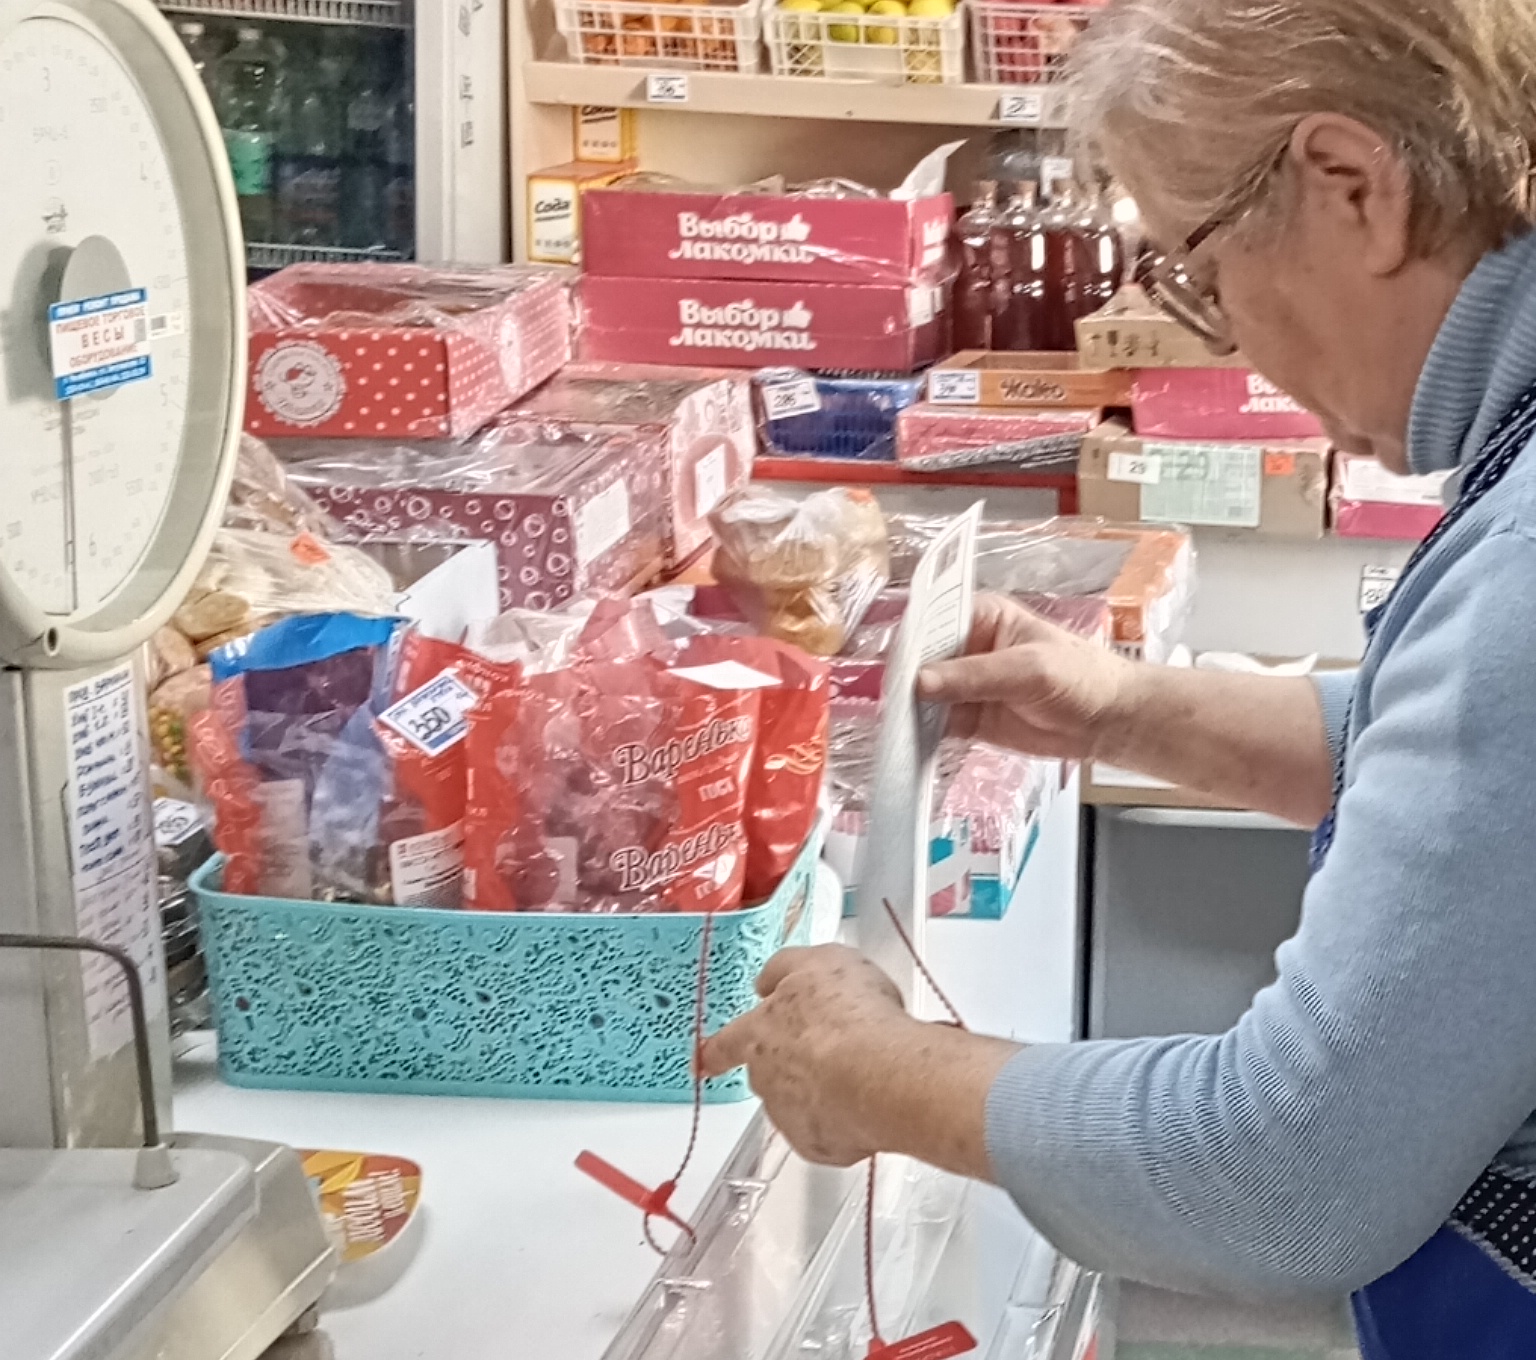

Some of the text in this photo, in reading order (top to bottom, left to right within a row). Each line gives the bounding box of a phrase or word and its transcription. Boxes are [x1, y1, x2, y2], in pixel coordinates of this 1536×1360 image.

[678, 211, 776, 240] Выбор
[668, 238, 816, 265] лакомки
[679, 298, 778, 331] Выбор
[81, 325, 125, 348] ВЕСЫ
[669, 326, 817, 352] лакомки
[1239, 395, 1307, 415] лако
[408, 706, 451, 740] 350
